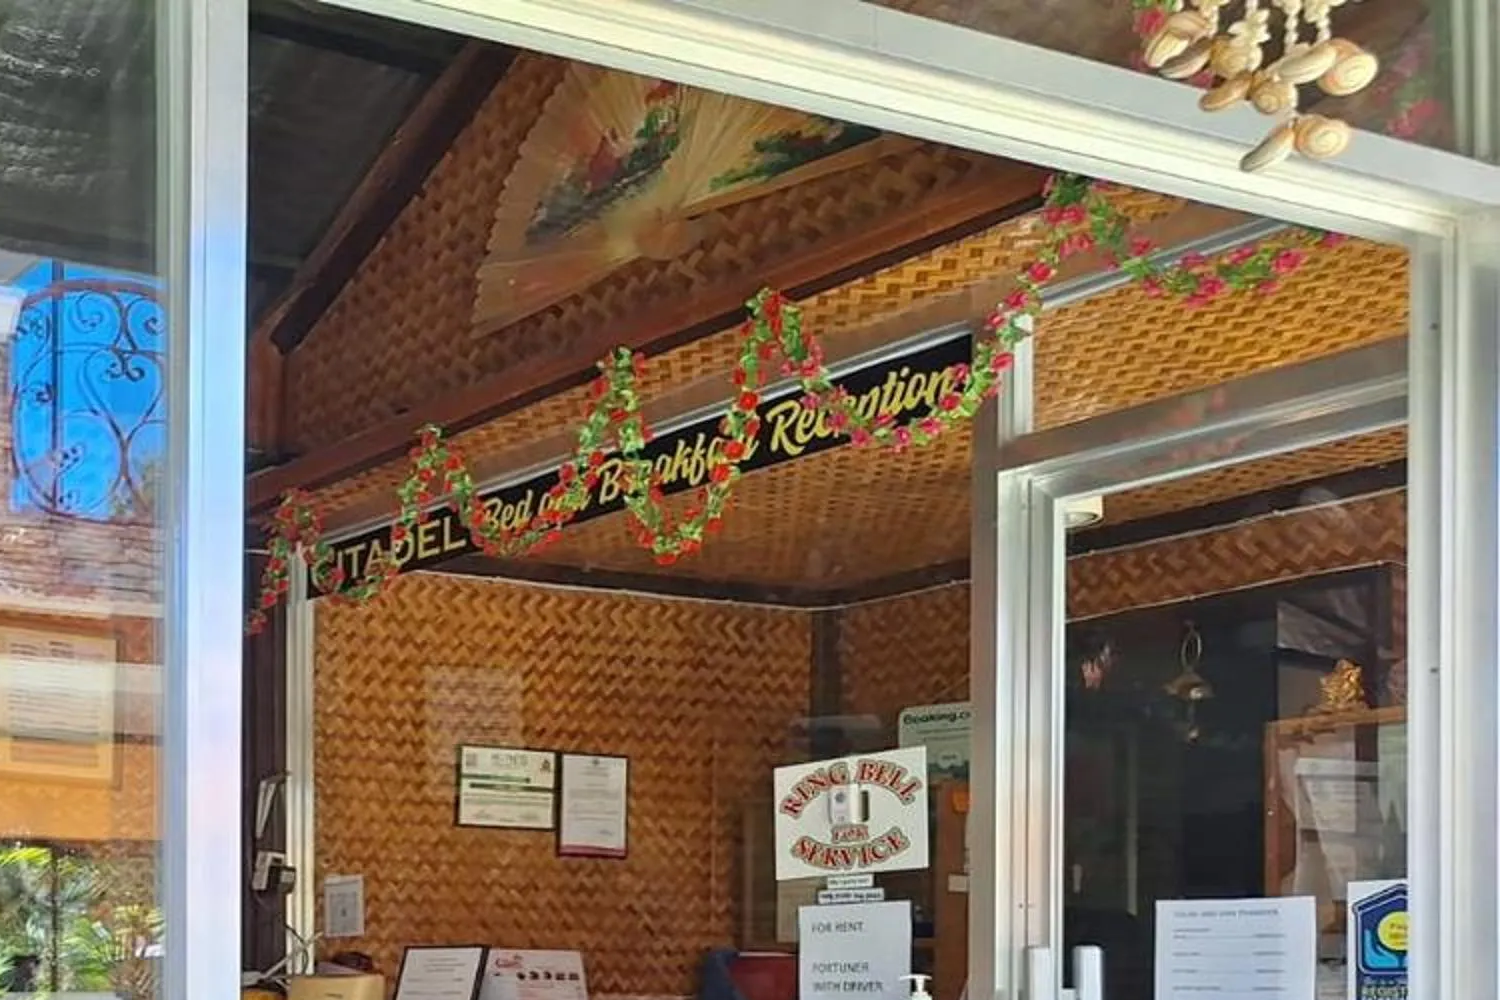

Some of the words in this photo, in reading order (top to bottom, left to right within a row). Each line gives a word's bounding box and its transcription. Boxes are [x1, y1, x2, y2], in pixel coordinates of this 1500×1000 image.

[483, 489, 533, 530] Bed
[765, 365, 962, 456] Recption
[781, 764, 848, 817] RING
[857, 761, 920, 803] BELL
